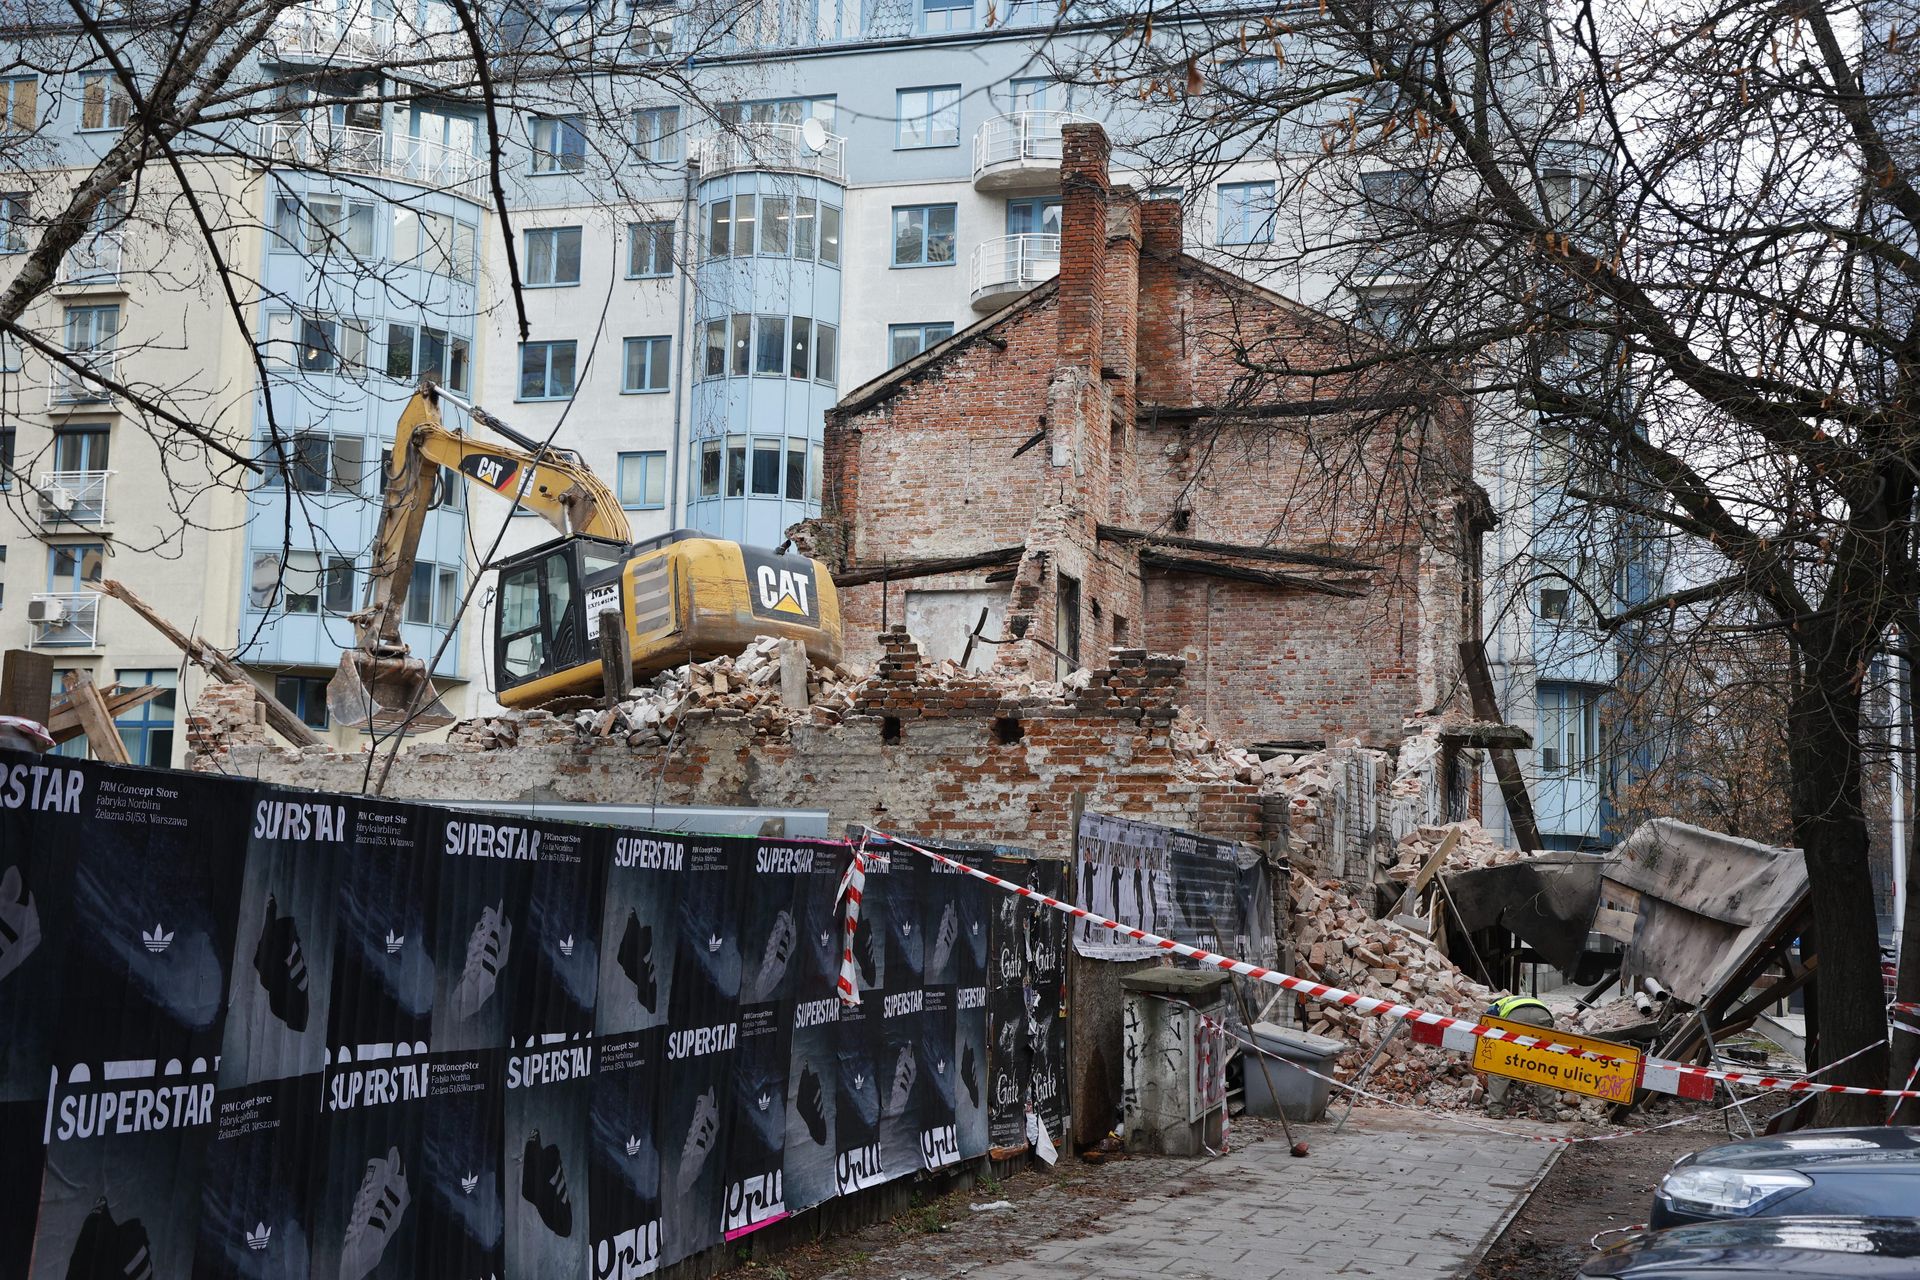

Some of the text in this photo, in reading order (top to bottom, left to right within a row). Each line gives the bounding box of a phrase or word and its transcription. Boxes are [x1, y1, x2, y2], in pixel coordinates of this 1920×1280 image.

[476, 456, 503, 487] CAT
[587, 596, 618, 610] EXPLOSION
[757, 565, 809, 617] CAT
[96, 795, 126, 808] Fabryka
[99, 780, 179, 799] PRM Concept Store
[149, 813, 188, 826] Warszawa
[445, 820, 541, 861] SUPERSTAR
[614, 836, 684, 871] SUPERSTAR
[795, 997, 840, 1029] SUPERSTAR
[884, 989, 923, 1019] SUPERSTAR
[667, 1022, 738, 1060] SUPERSTAR
[1504, 1053, 1559, 1080] stroną
[1563, 1066, 1602, 1089] ulicy
[57, 1083, 215, 1141] SUPERSTAR
